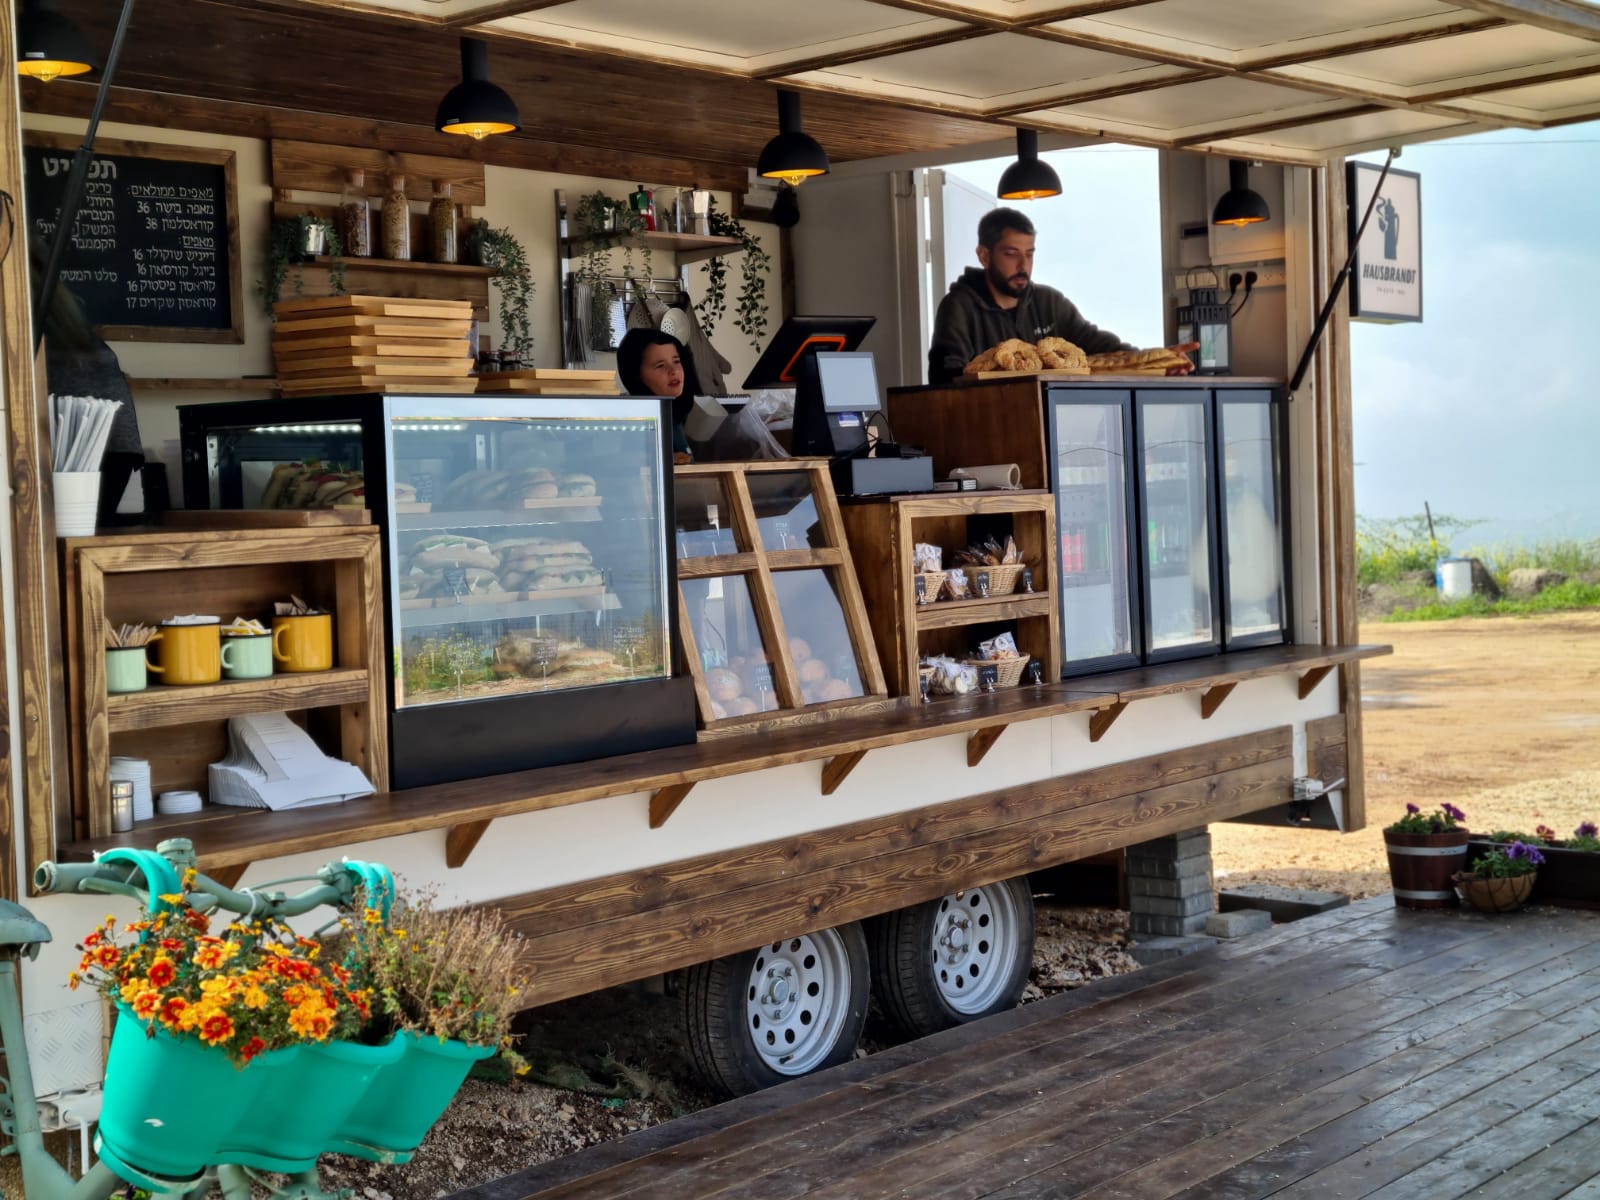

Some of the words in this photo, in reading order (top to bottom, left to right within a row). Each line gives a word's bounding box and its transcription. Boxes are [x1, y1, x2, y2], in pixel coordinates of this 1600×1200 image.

[42, 156, 117, 180] תפיט
[179, 187, 214, 199] מאפים
[137, 200, 151, 214] 36
[186, 203, 214, 215] מאפה
[145, 216, 158, 230] 38
[132, 248, 144, 261] 16
[145, 244, 183, 262] שוקולד
[95, 267, 118, 282] סלט
[137, 263, 147, 276] 16
[1363, 264, 1416, 284] HAUSBRANDT
[127, 280, 138, 292] 16
[139, 279, 176, 293] פיסטוק
[126, 297, 137, 310] 17
[139, 297, 175, 311] שקדים
